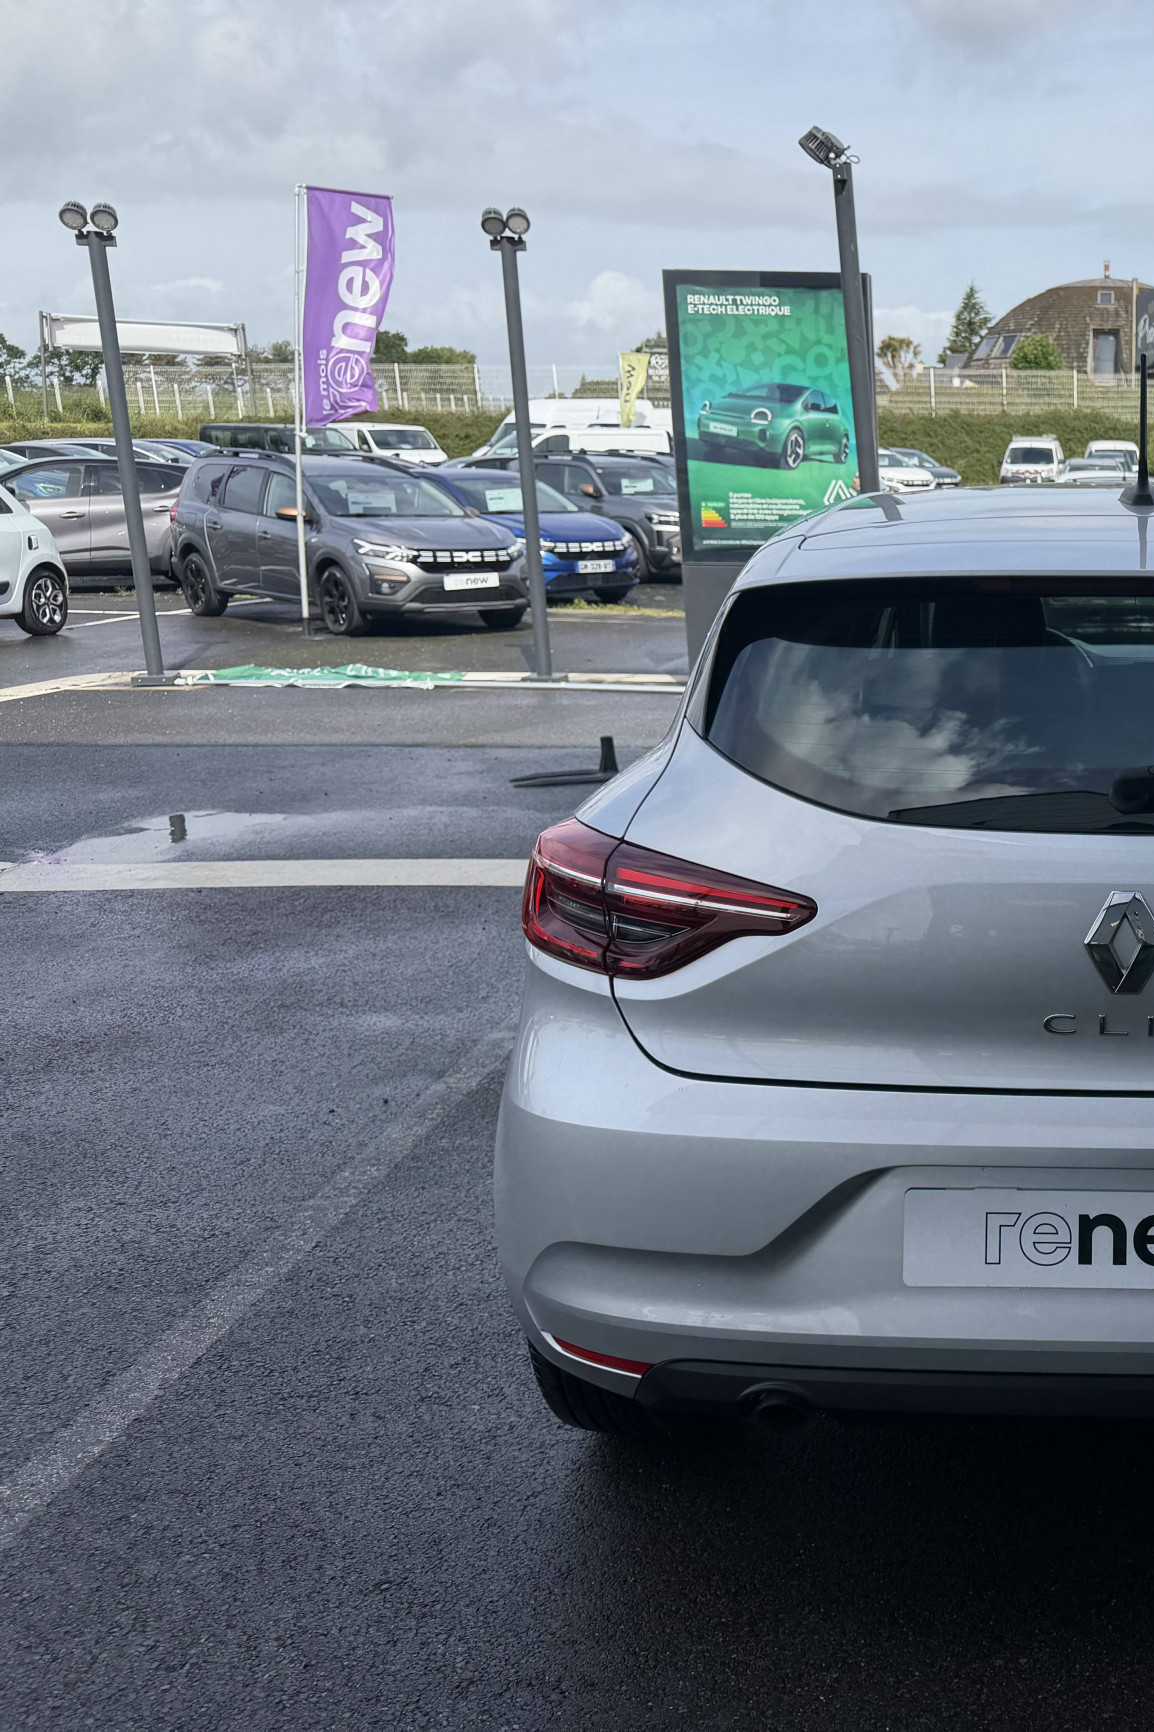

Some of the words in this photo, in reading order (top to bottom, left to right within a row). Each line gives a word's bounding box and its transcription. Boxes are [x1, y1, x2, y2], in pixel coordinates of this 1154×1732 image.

[687, 294, 733, 304] RENAULT
[734, 295, 779, 305] TWINGO
[687, 304, 725, 314] E-TECH
[726, 305, 791, 316] ELECTRIQUE
[317, 349, 328, 395] mois
